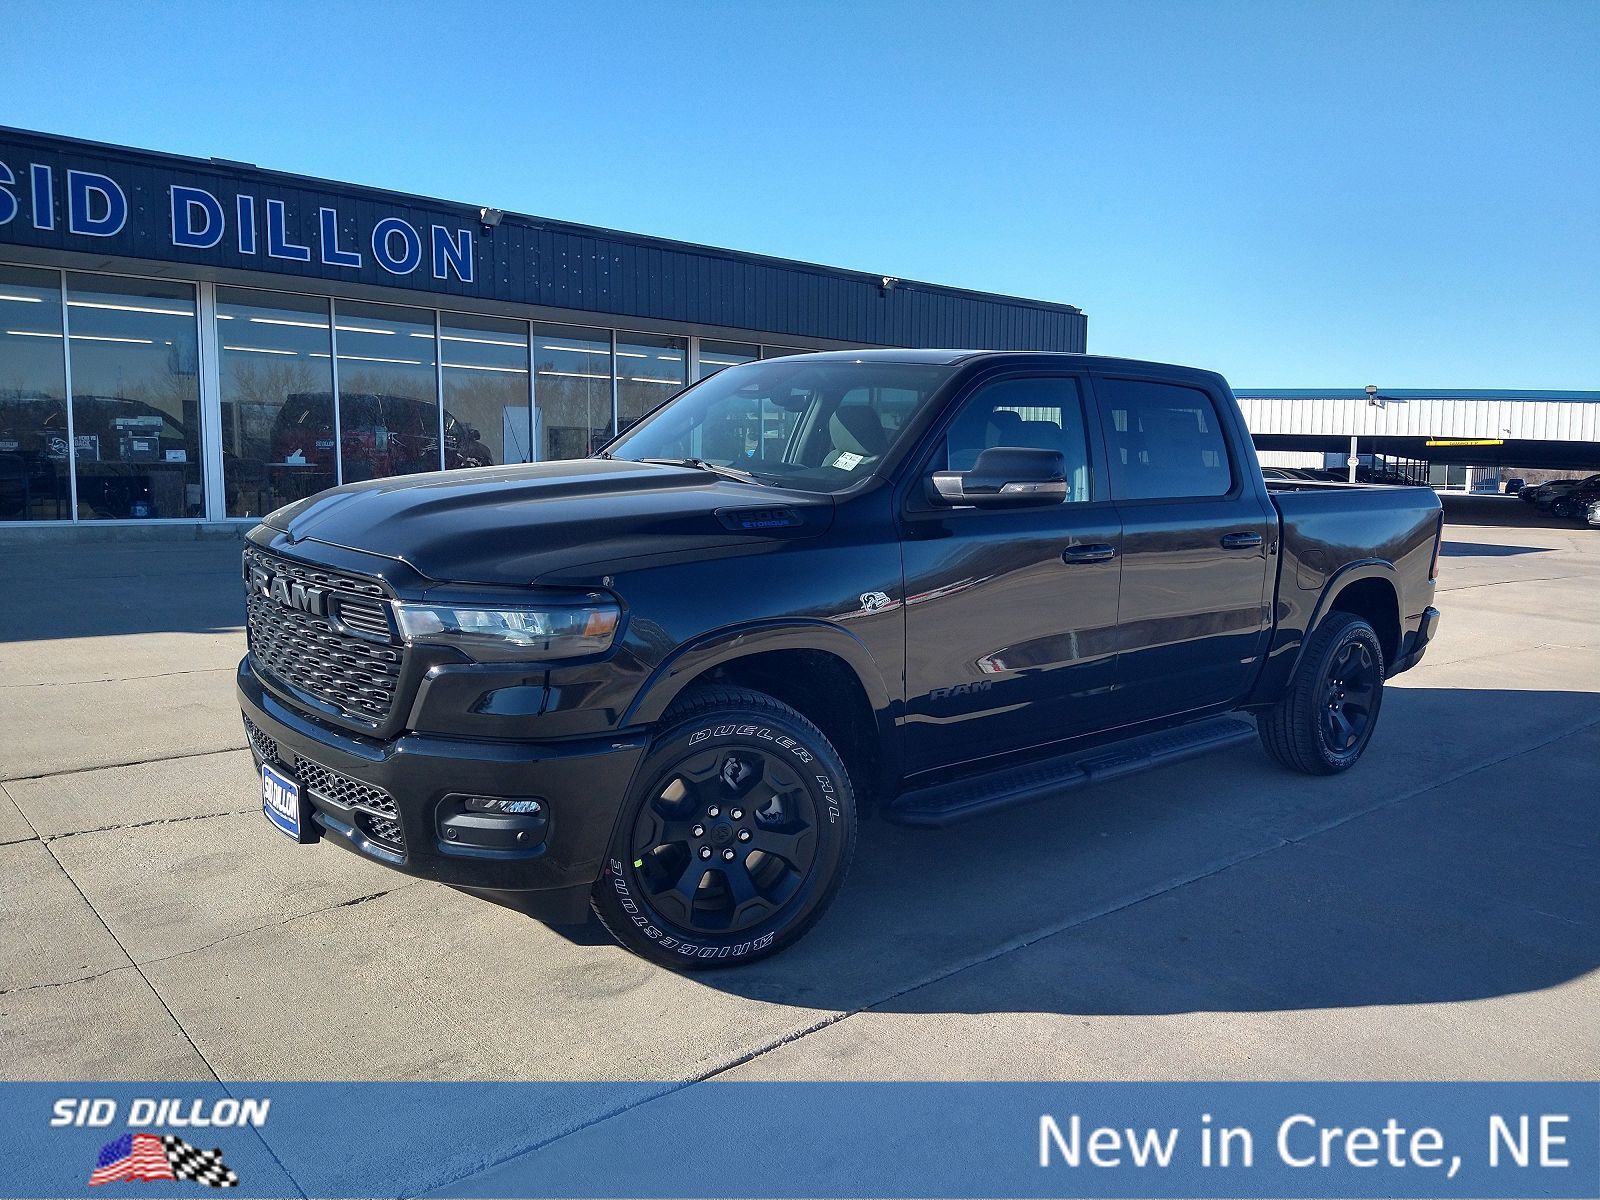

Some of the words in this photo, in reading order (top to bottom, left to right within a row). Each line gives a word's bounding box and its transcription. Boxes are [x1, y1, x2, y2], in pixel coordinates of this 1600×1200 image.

[170, 184, 474, 283] DILLON
[252, 566, 327, 617] RAM
[929, 680, 992, 701] RAM
[688, 724, 814, 764] DUELER
[610, 858, 775, 958] BRIDGESTONE
